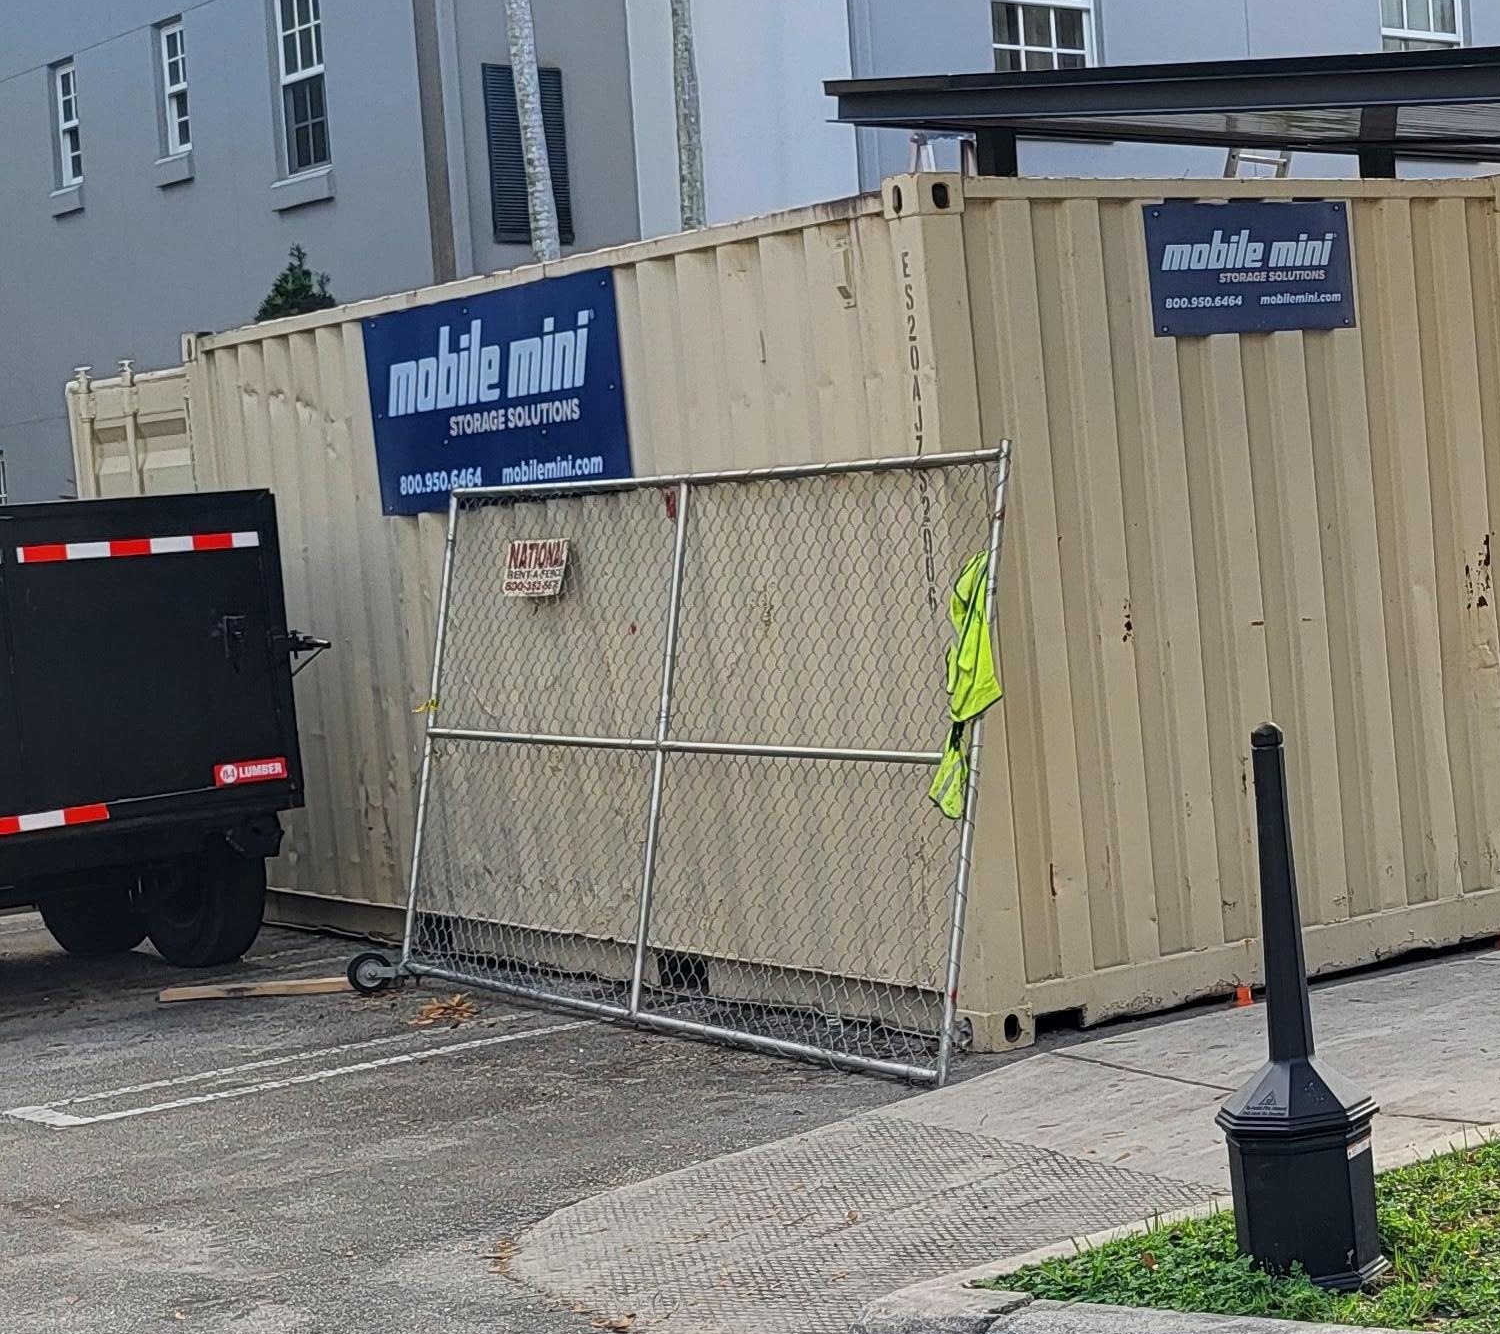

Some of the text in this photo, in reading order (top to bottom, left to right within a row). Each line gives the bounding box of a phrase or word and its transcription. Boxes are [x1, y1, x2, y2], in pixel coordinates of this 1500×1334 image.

[1161, 229, 1334, 271] mobile mini
[1219, 269, 1326, 284] STORAGE SOLUTIONS
[1165, 291, 1342, 309] 800.950.6464 mobilemini.com
[388, 310, 590, 418] mobile mini
[450, 398, 581, 436] STORAGE SOLUTIONS
[400, 455, 604, 495] 800.950.6464 mobilemini.com
[508, 542, 565, 569] NATIONAL
[239, 762, 283, 778] LUMBER
